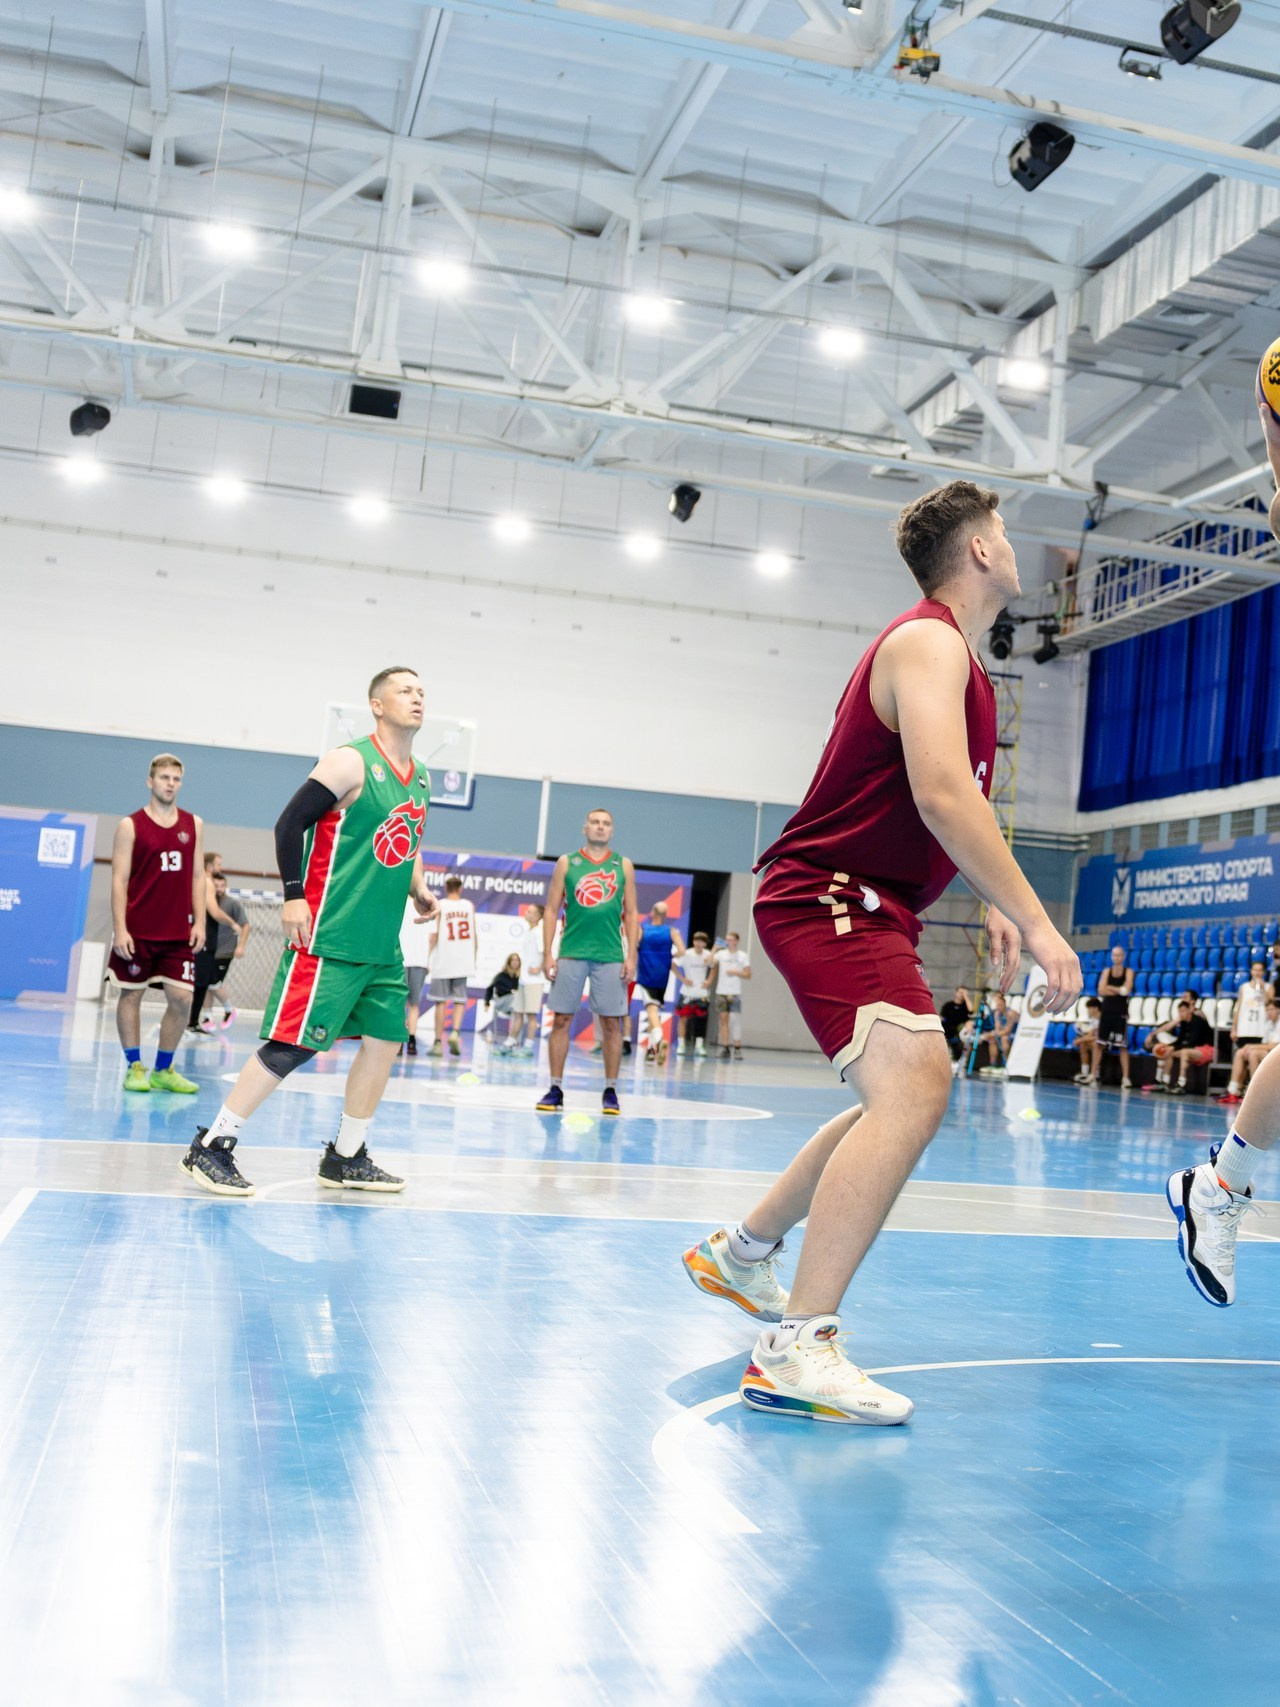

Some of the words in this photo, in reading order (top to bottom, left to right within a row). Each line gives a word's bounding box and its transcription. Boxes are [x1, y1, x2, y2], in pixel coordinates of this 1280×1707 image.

[160, 851, 182, 872] 13
[1135, 862, 1223, 888] МИНИСТЕРСТВО
[1224, 856, 1274, 881] СПОРТА
[485, 876, 545, 896] РОССИИ
[1134, 884, 1213, 909] ПРИМОРСКОГО
[1214, 882, 1249, 903] КРАЯ
[447, 920, 470, 940] 12
